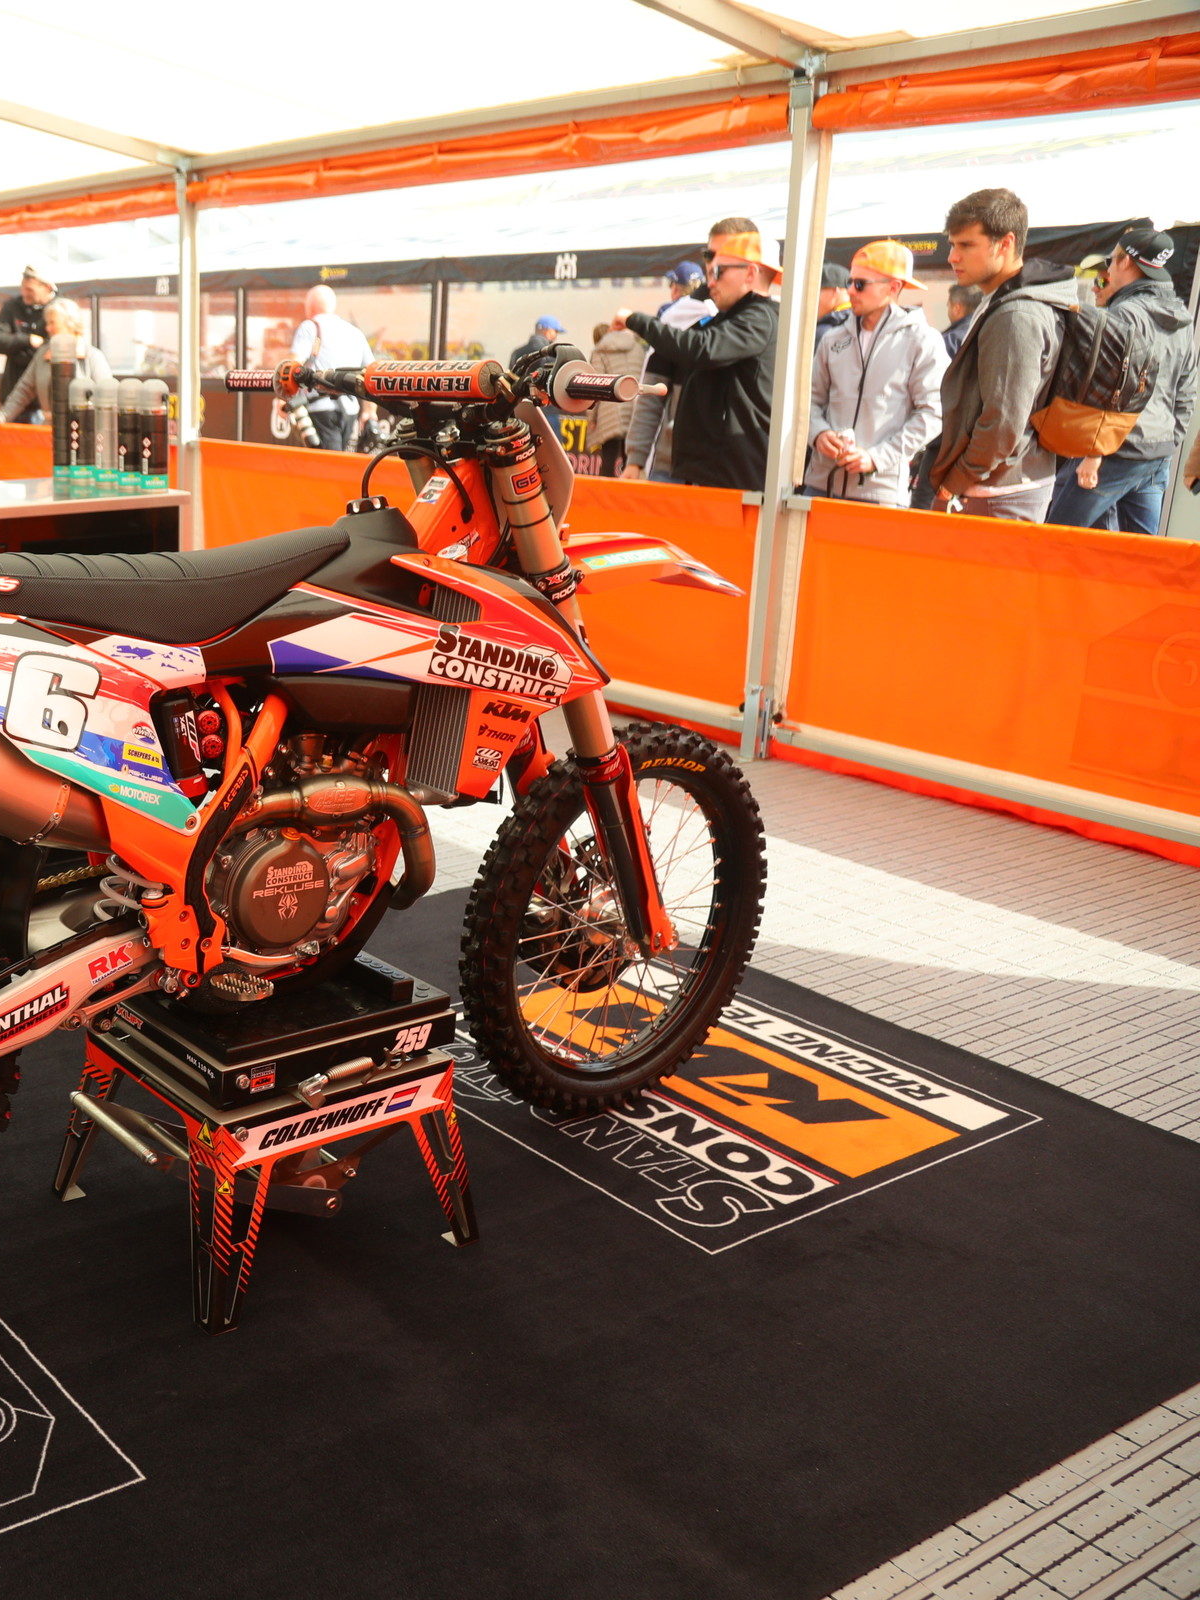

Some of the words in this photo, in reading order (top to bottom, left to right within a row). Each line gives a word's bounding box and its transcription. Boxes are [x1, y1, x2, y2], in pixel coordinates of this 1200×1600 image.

[370, 376, 472, 392] RENTHAL
[573, 374, 615, 386] RENTHAL
[434, 622, 559, 680] STANDING
[430, 654, 566, 704] CONSTRUCT
[3, 650, 102, 752] 6
[482, 699, 531, 724] KTM
[486, 728, 517, 743] THOR
[127, 749, 151, 761] SCHEPERS
[639, 757, 707, 773] DUNLOP
[119, 784, 161, 805] MOTOREX
[223, 768, 249, 811] ACERBIS
[266, 872, 312, 886] CONSTRUCT
[267, 863, 308, 878] STANDING
[253, 879, 325, 899] REKLUSE
[87, 943, 132, 981] RK
[393, 1023, 433, 1053] 259
[186, 1053, 197, 1066] MAX
[770, 1031, 952, 1102] RACING
[258, 1096, 387, 1150] GOLDENHOFF
